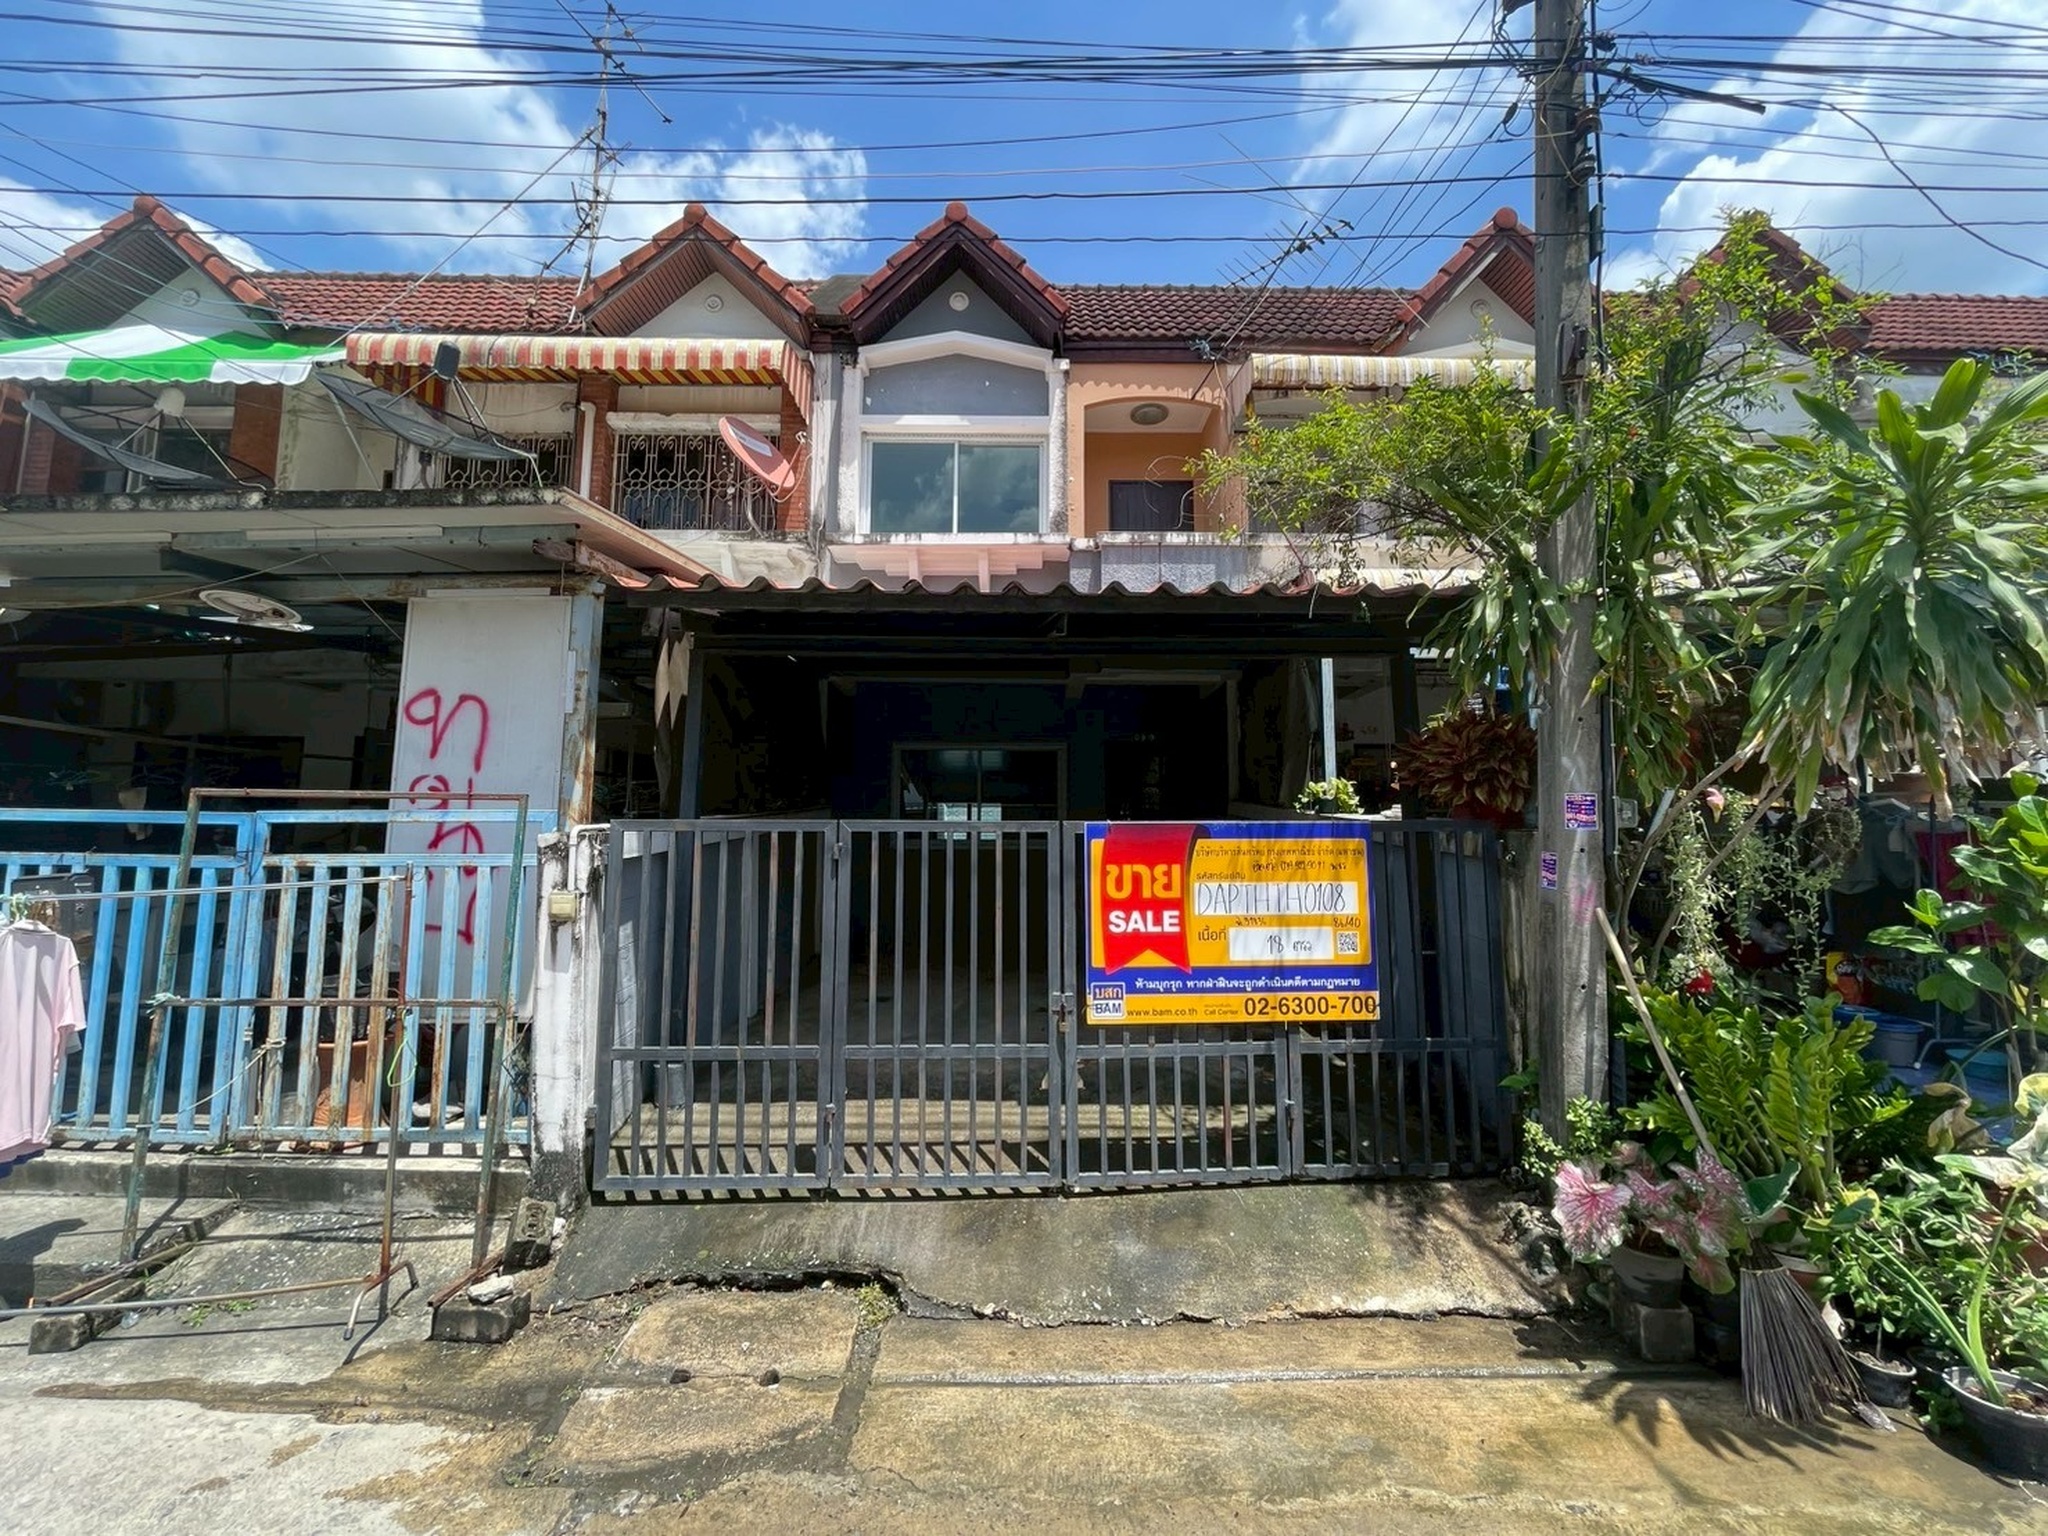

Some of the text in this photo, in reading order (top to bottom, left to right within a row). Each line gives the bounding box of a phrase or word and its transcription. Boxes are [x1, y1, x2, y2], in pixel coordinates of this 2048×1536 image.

[1106, 864, 1181, 899] ขาย
[1108, 910, 1181, 933] SALE
[1198, 925, 1227, 941] เนื้อที่
[1266, 935, 1284, 955] 18
[1135, 977, 1182, 992] ห้ามบุกรุก
[1095, 988, 1122, 999] บสก
[1095, 1002, 1122, 1014] BAM
[1127, 1007, 1197, 1017] www.bam.co.th
[1244, 996, 1376, 1016] 02-6300-700
